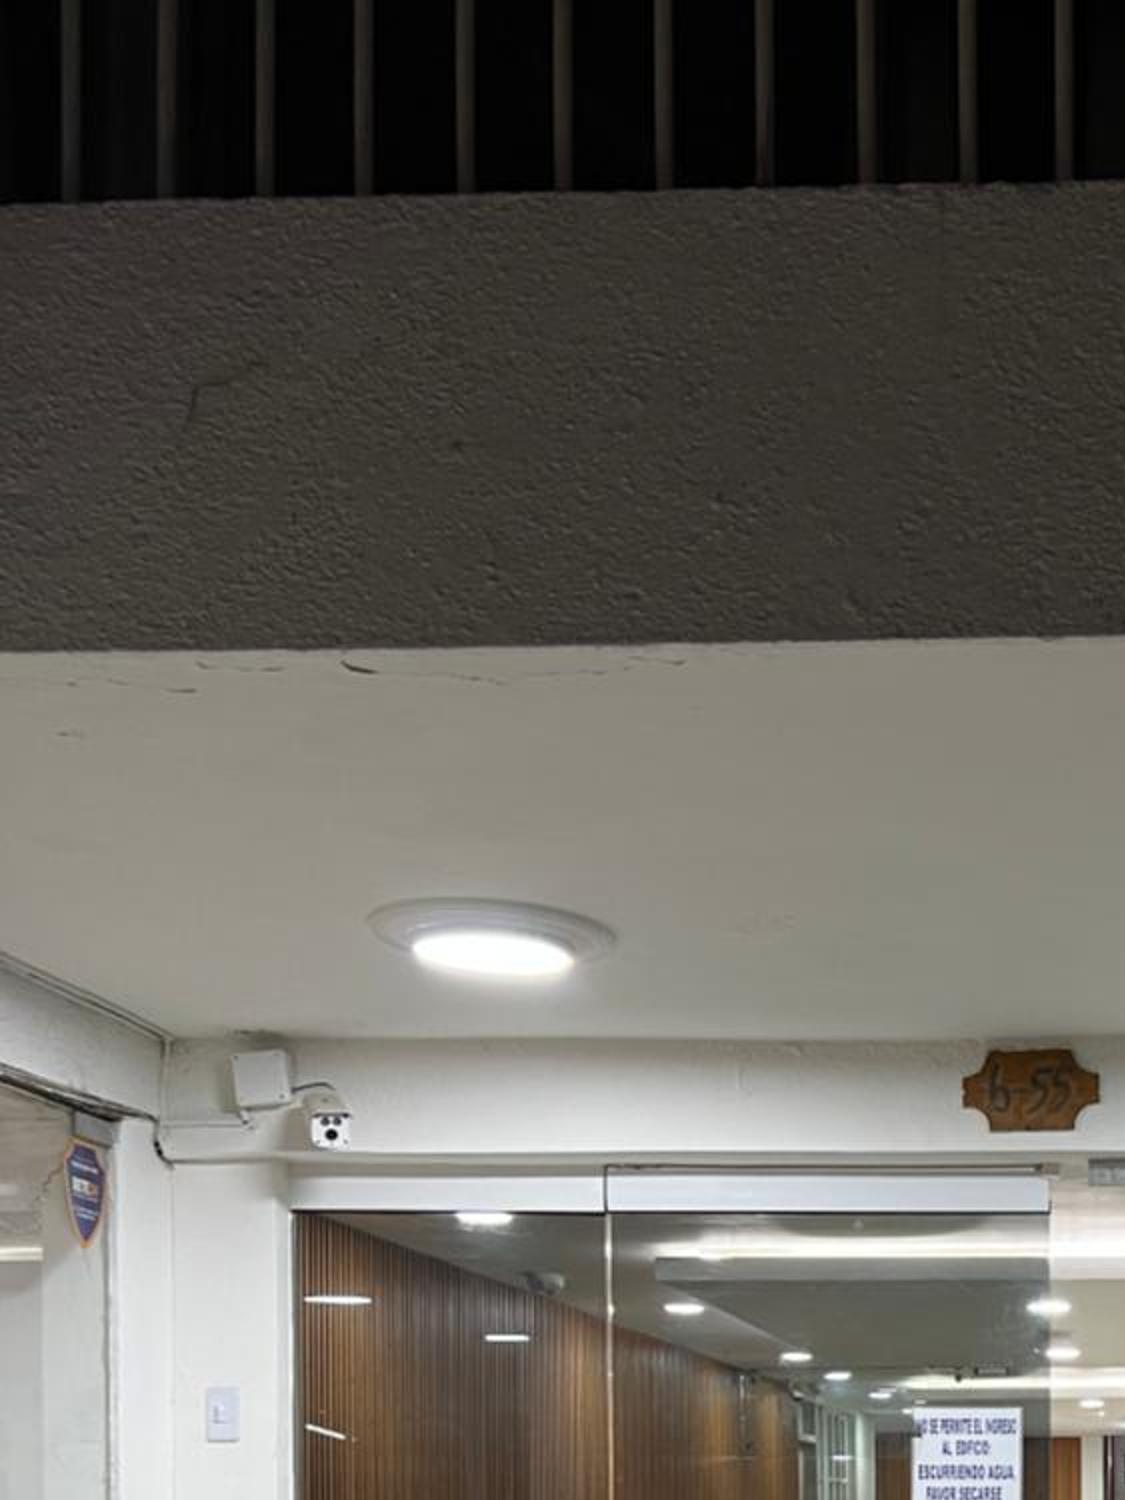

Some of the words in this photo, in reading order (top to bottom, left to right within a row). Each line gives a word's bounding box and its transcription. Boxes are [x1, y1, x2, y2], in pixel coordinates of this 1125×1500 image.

[918, 1464, 986, 1480] ESCURRIENDO
[926, 1486, 957, 1500] FAVOR
[959, 1486, 1002, 1500] SECARSE
